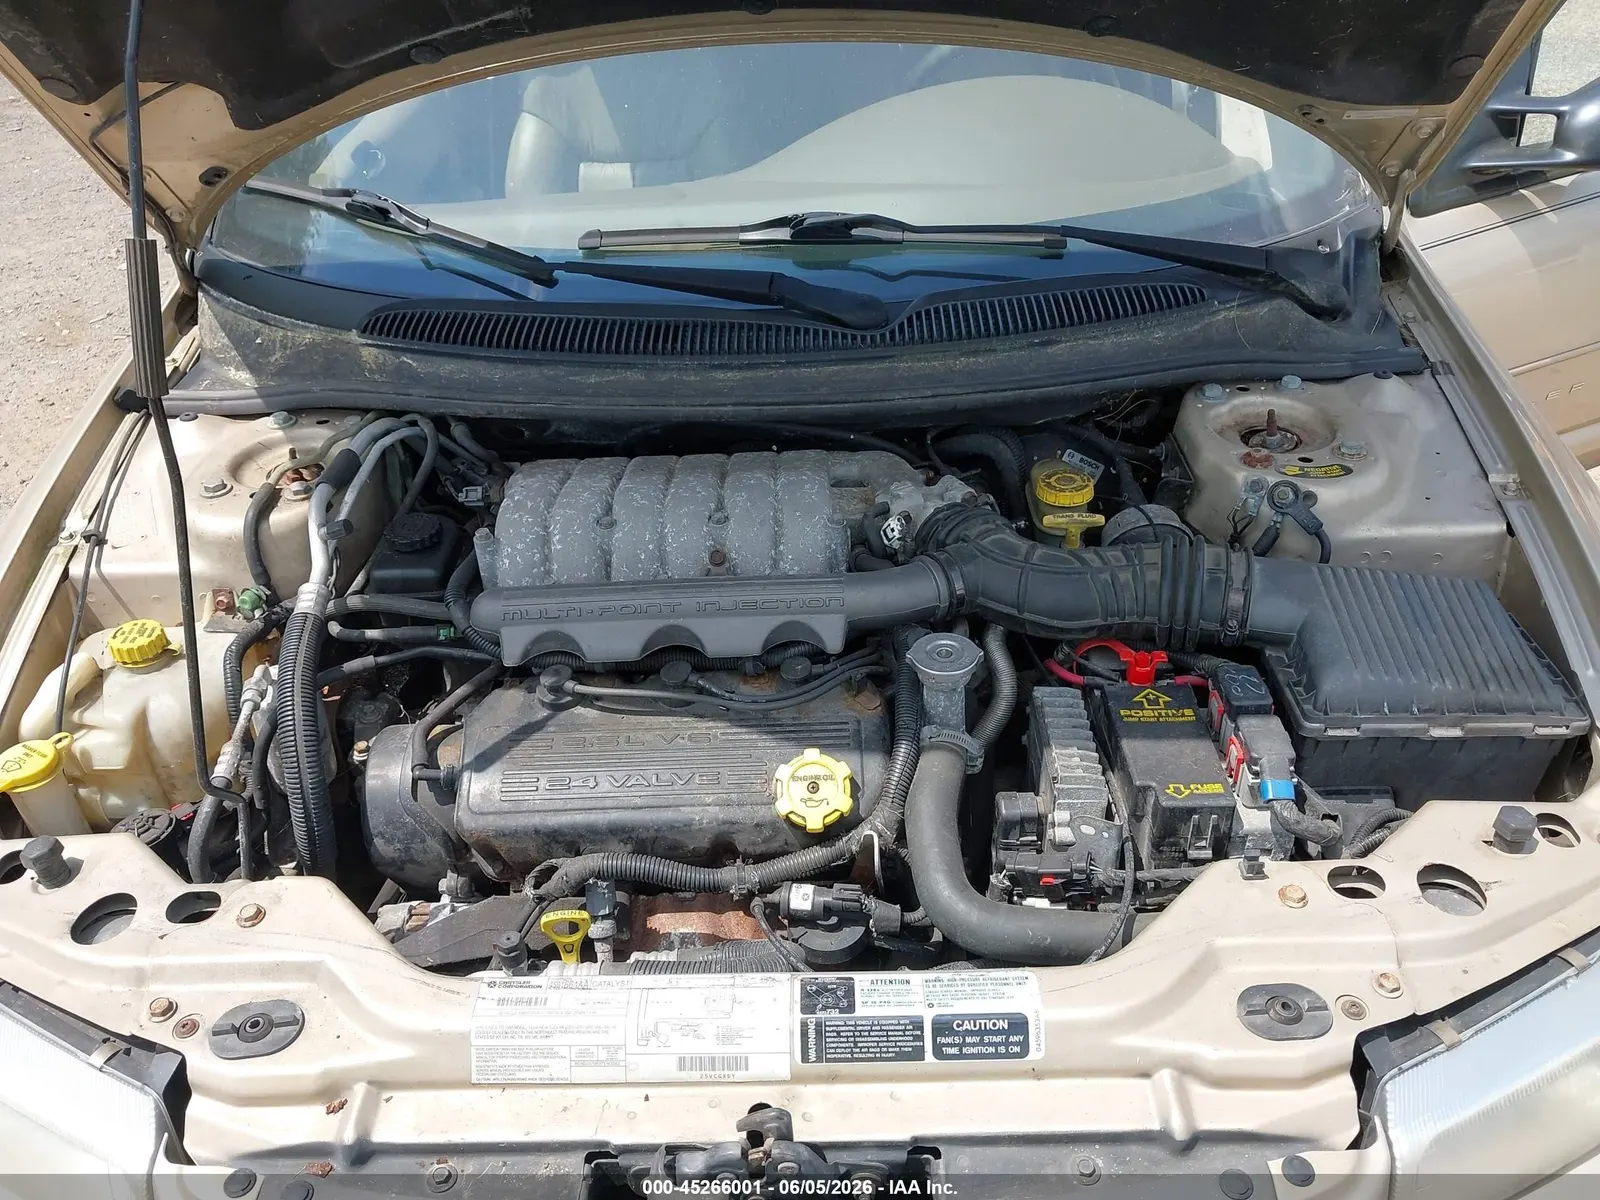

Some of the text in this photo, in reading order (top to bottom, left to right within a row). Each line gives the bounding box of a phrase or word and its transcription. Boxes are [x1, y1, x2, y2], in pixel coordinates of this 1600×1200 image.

[1078, 457, 1100, 471] BOSCH
[502, 596, 844, 621] MULTI-POINT INJECTION
[1120, 708, 1195, 716] POSITIVE
[546, 771, 721, 790] 24 VALVE
[546, 910, 584, 918] ENGINE
[592, 980, 630, 988] CATALYST
[952, 1019, 1008, 1032] CAUTION
[807, 1018, 816, 1062] WARNING
[936, 1036, 963, 1044] FAN(S)
